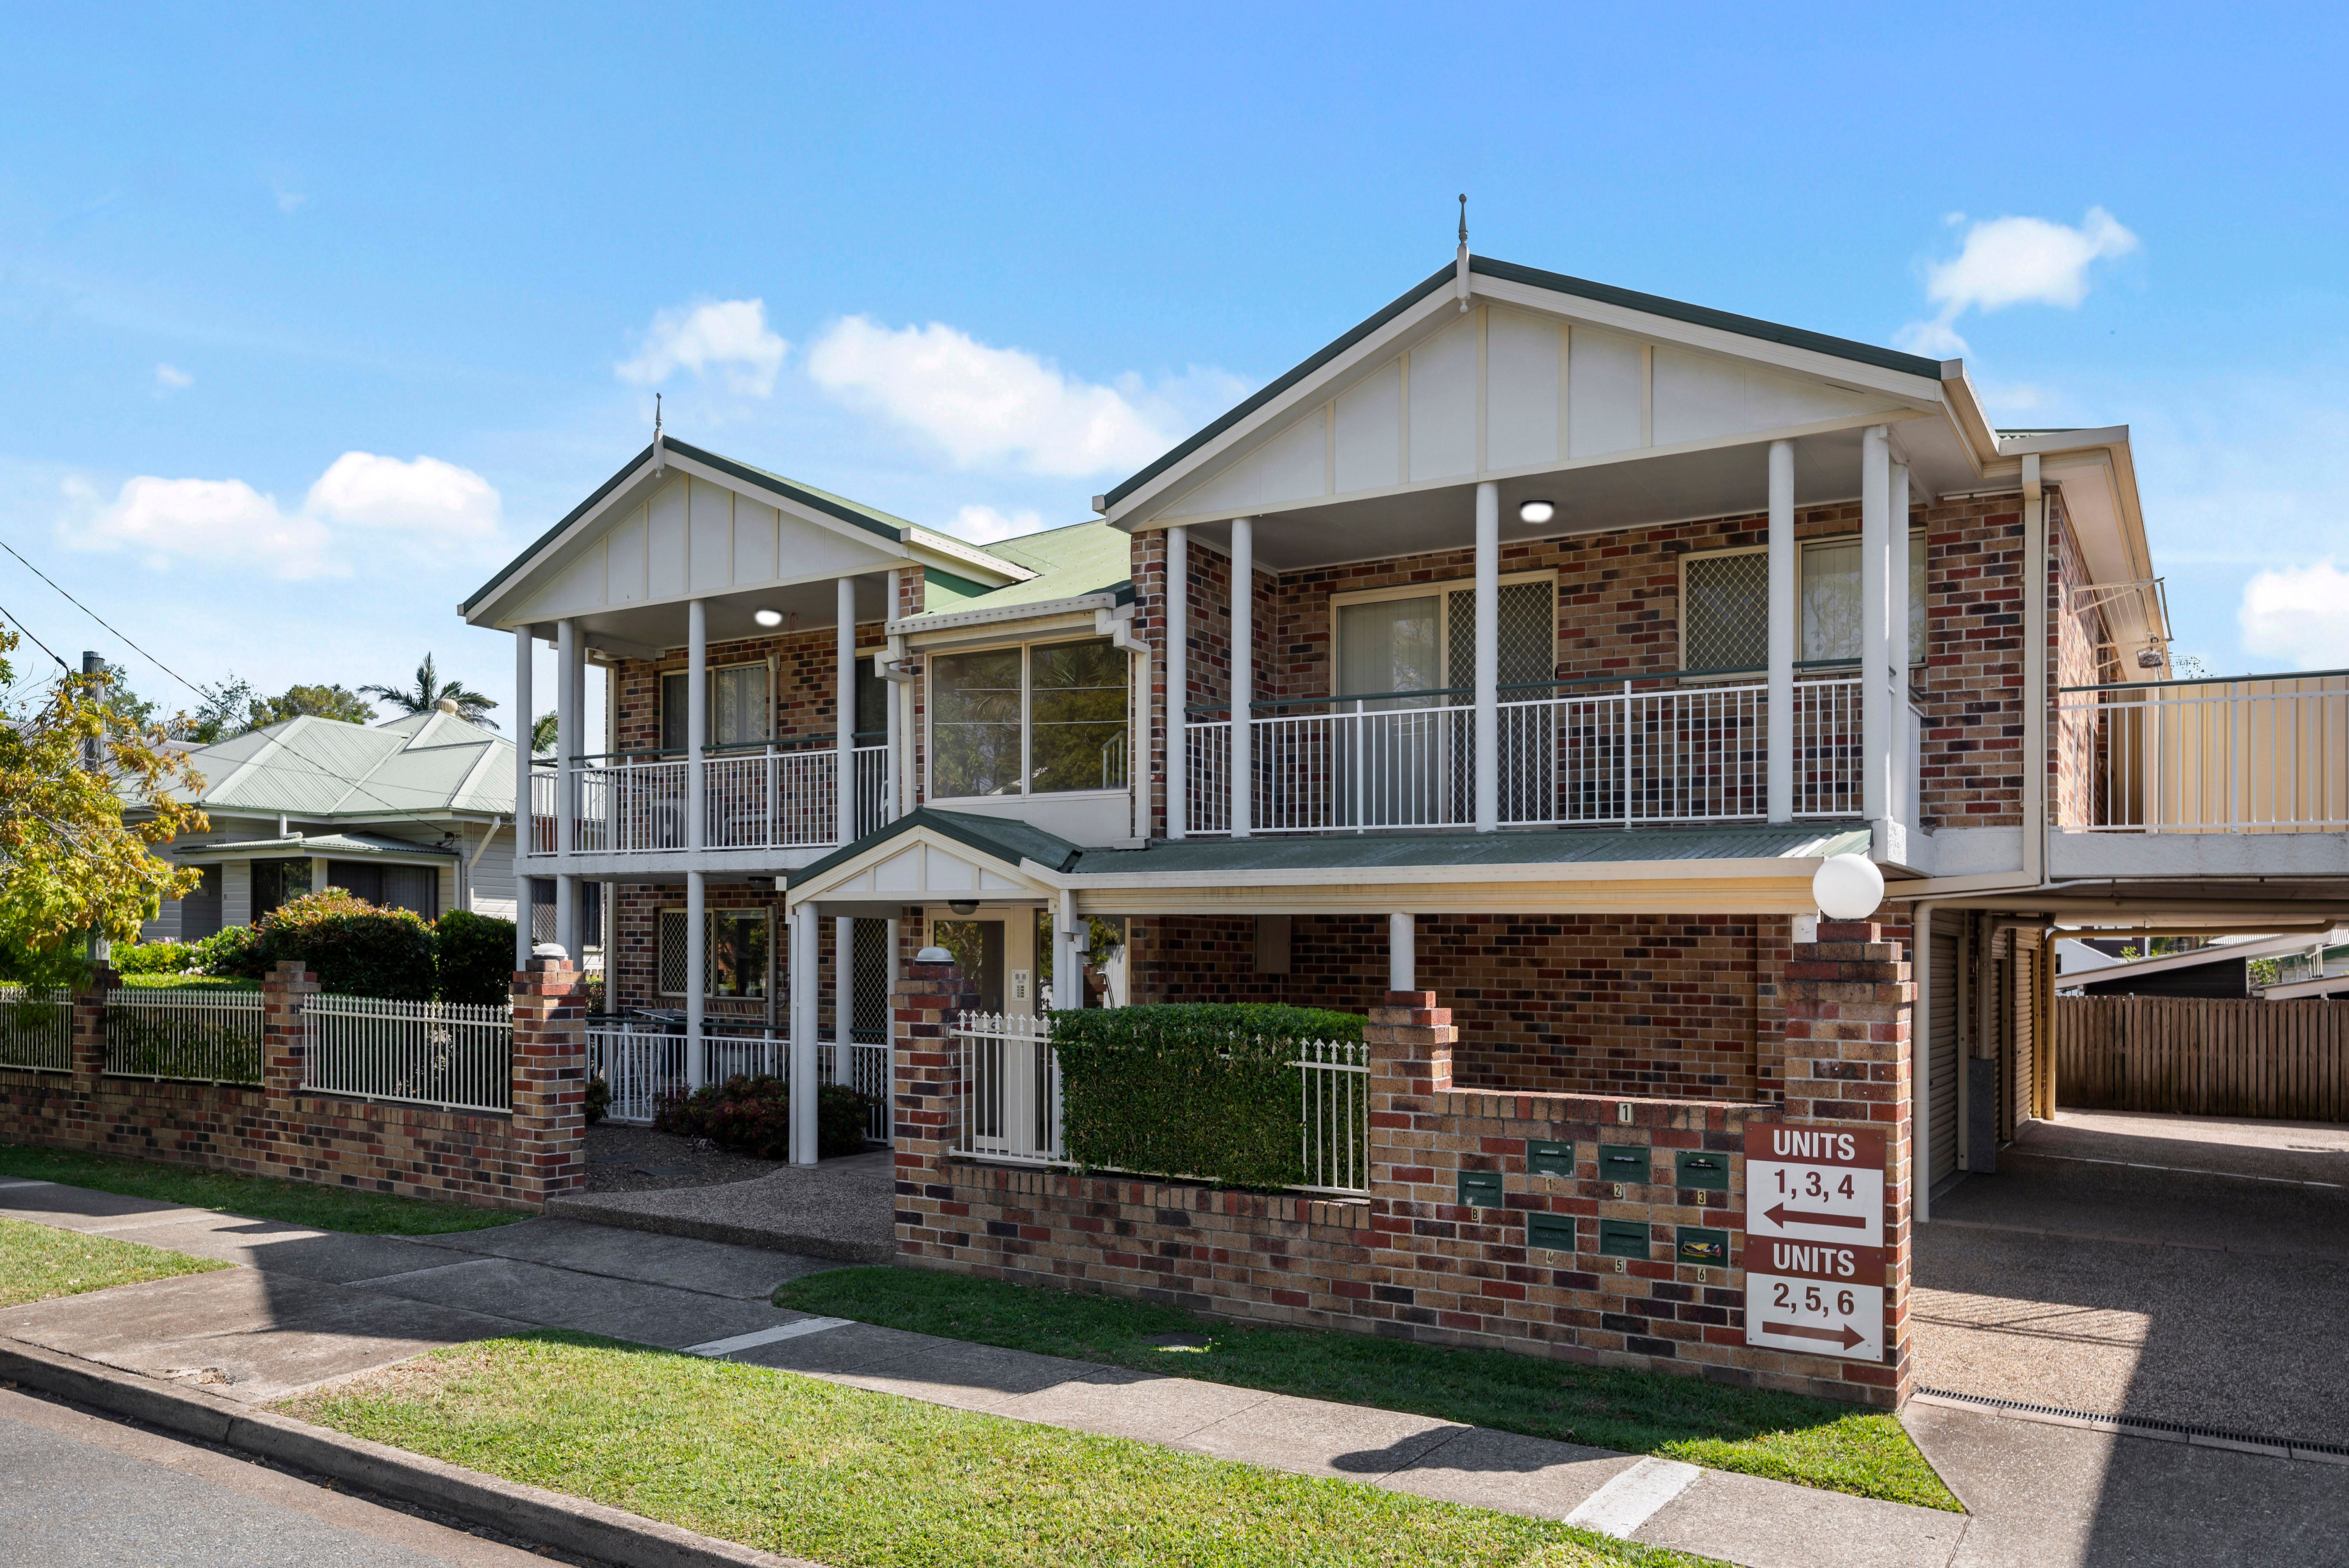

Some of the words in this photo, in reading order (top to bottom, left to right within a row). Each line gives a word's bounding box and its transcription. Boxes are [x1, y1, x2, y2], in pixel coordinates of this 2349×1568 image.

[1623, 1105, 1628, 1121] 1
[1774, 1130, 1855, 1161] UNITS
[1547, 1179, 1551, 1190] 1
[1616, 1184, 1620, 1196] 2
[1774, 1169, 1797, 1200] 1,
[1805, 1171, 1829, 1203] 3,
[1838, 1174, 1855, 1200] 4
[1699, 1191, 1704, 1203] 3
[1473, 1209, 1478, 1219] B
[1547, 1252, 1552, 1263] 4
[1774, 1243, 1855, 1276] UNITS
[1617, 1260, 1622, 1271] 5
[1699, 1269, 1704, 1280] 6
[1774, 1283, 1797, 1314] 2,
[1805, 1286, 1828, 1318] 5,
[1837, 1290, 1855, 1315] 6
